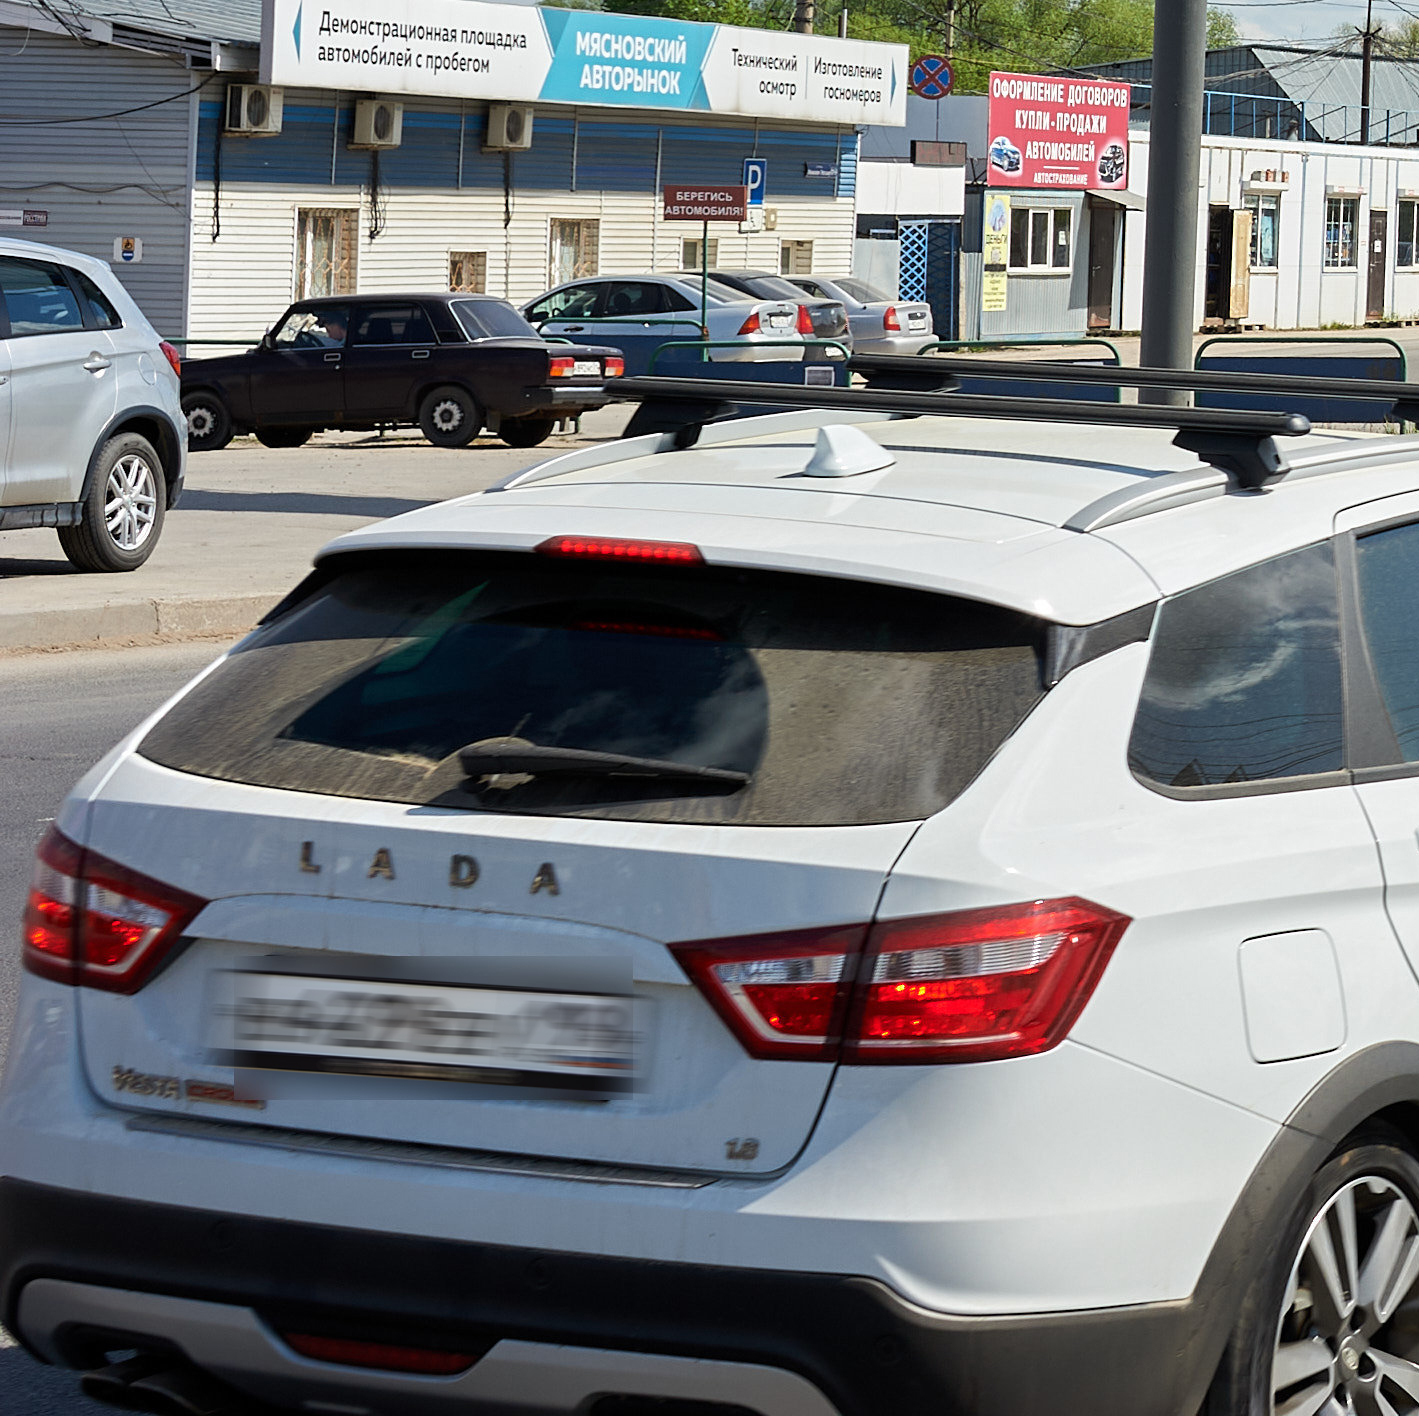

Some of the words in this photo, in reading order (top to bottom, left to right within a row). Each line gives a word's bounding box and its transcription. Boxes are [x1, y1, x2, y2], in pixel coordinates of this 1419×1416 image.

[319, 10, 457, 44] Демонстрационная
[460, 28, 527, 49] площадка
[318, 44, 412, 67] автомобилей
[416, 53, 423, 67] с
[426, 52, 490, 75] пробегом
[576, 31, 687, 65] МЯСНОВСКИЙ
[732, 48, 798, 72] Технический
[579, 64, 681, 95] АВТОРЫНОК
[813, 56, 883, 80] Изготовление
[759, 78, 796, 100] осмотр
[823, 85, 881, 106] госномеров
[993, 78, 1064, 103] ОФОРМЛЕНИЕ
[1067, 85, 1128, 108] ДОГОВОРОВ
[1025, 141, 1095, 162] АВТОМОБИЛЕЙ
[1033, 172, 1088, 185] АВТОСТРАХОВАНИЕ
[676, 191, 733, 202] БЕРЕГИСЬ
[665, 205, 744, 217] АВТОМОБИЛЯ!
[300, 841, 560, 896] LADA
